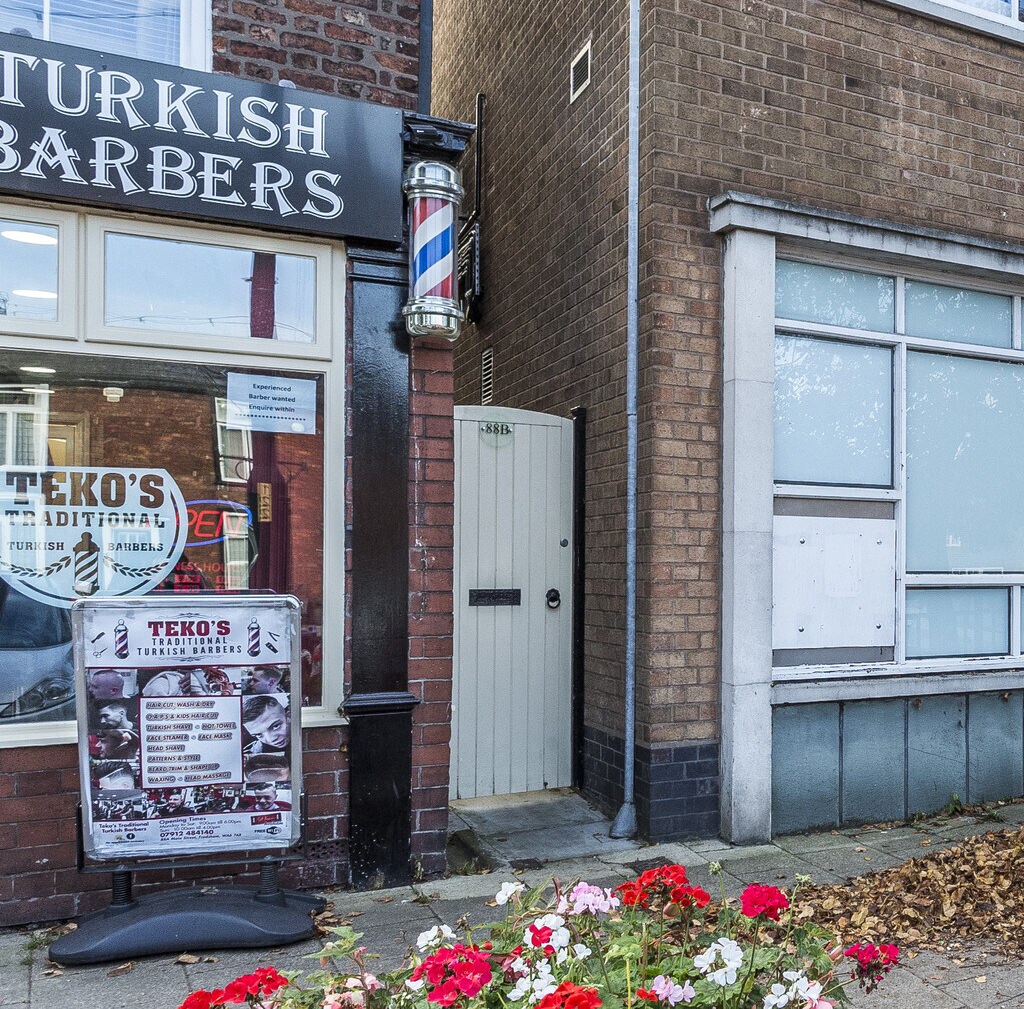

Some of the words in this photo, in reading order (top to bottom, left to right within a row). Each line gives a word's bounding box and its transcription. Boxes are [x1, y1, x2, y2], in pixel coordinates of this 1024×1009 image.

[0, 50, 331, 159] TURKISH
[252, 383, 292, 392] Experienced
[248, 393, 270, 401] Barber
[248, 404, 274, 412] Enquire
[485, 423, 510, 435] 88B
[6, 471, 165, 509] TEKO'S
[5, 510, 165, 529] TRADITIONAL
[180, 509, 244, 537] PEN
[8, 542, 65, 551] TURKISH
[107, 543, 164, 552] BARBERS
[148, 620, 231, 637] TEKO'S
[152, 637, 228, 646] TRADITIONAL
[137, 647, 186, 656] TURKISH
[193, 646, 242, 655] BARBERS
[202, 772, 231, 780] MASSAGE
[159, 817, 187, 825] Opening
[185, 829, 214, 837] 484140
